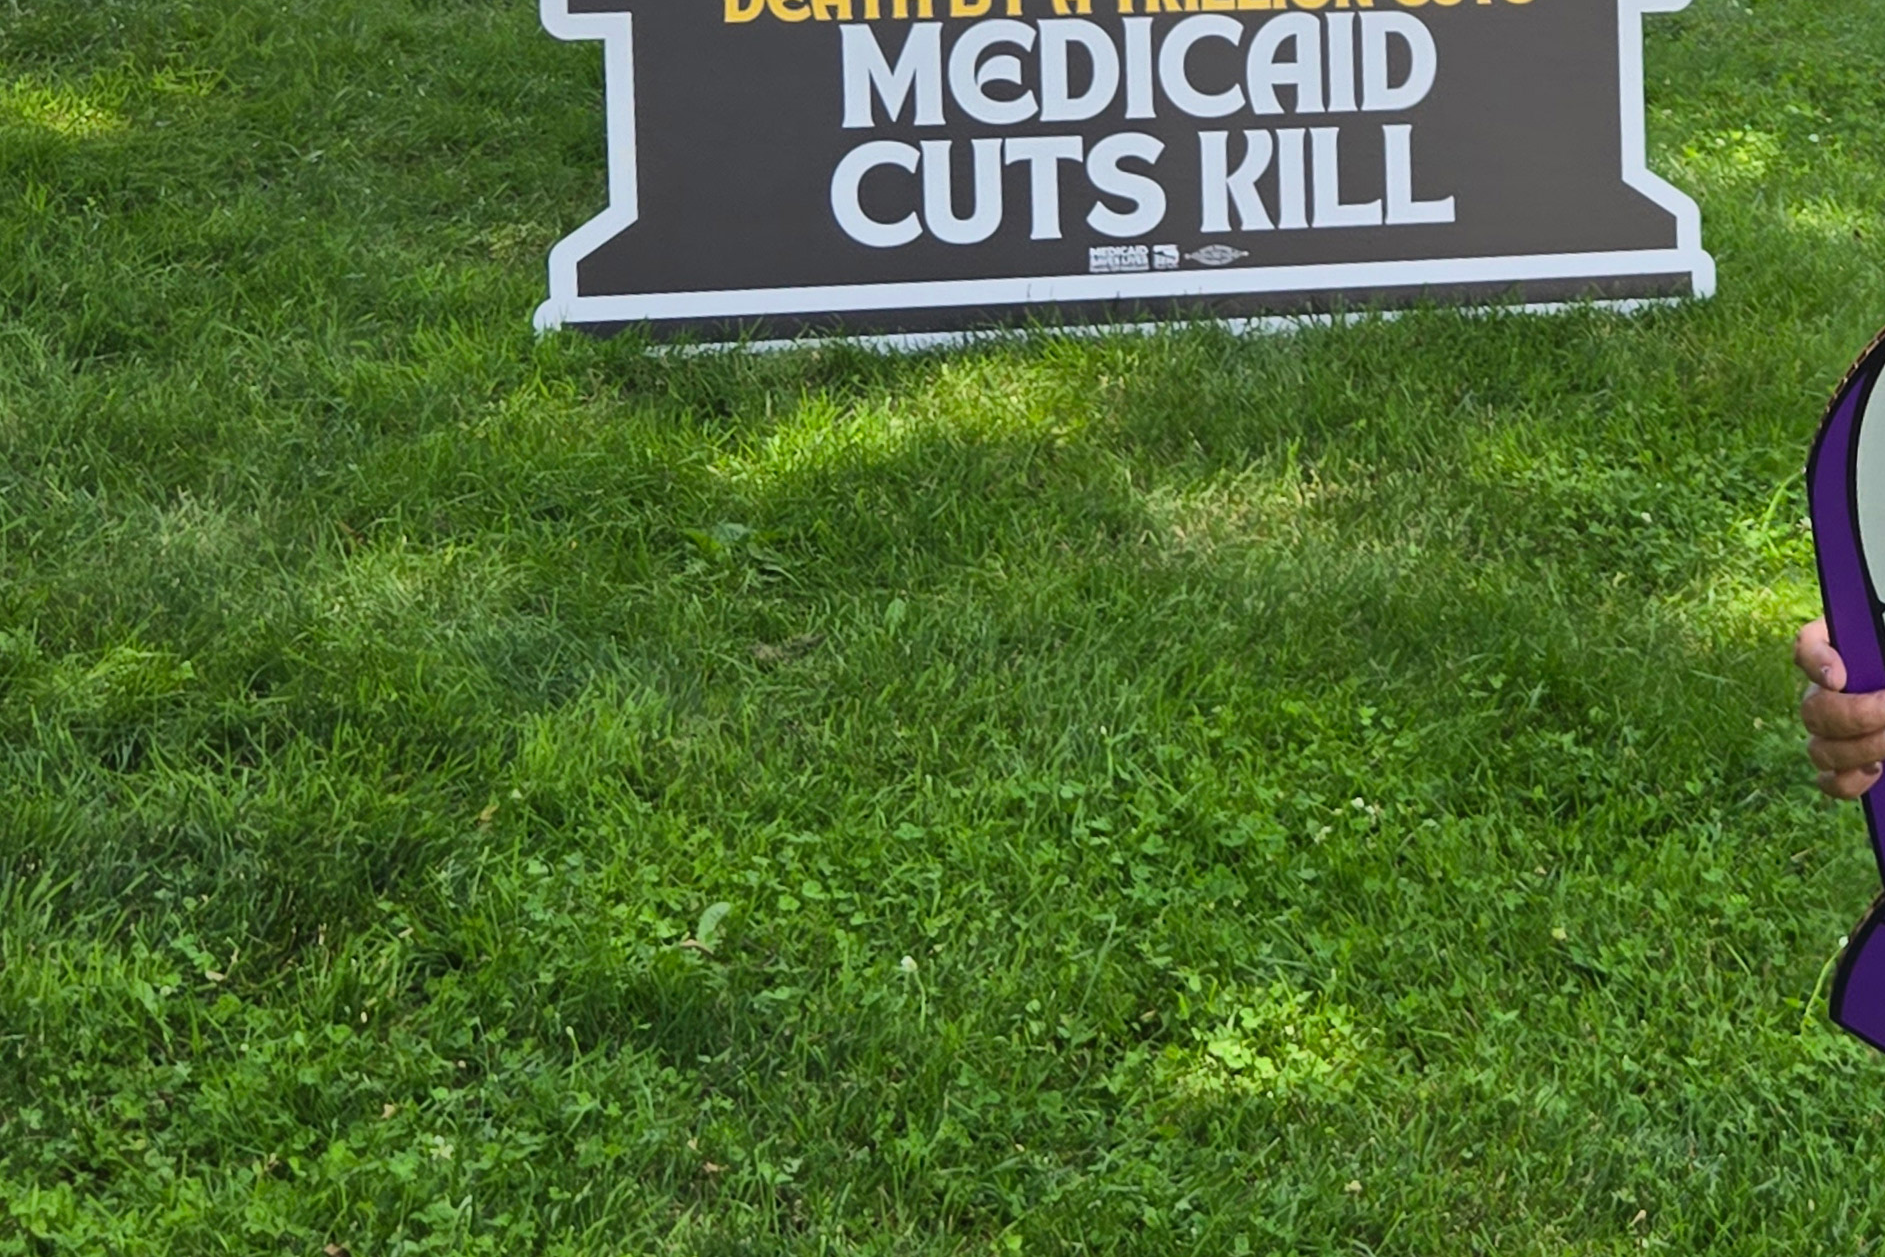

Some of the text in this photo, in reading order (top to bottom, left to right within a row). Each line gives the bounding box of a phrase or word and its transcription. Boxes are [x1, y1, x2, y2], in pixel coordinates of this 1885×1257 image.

[840, 11, 1438, 129] MEDICAID
[830, 124, 1456, 248] CUTS KILL
